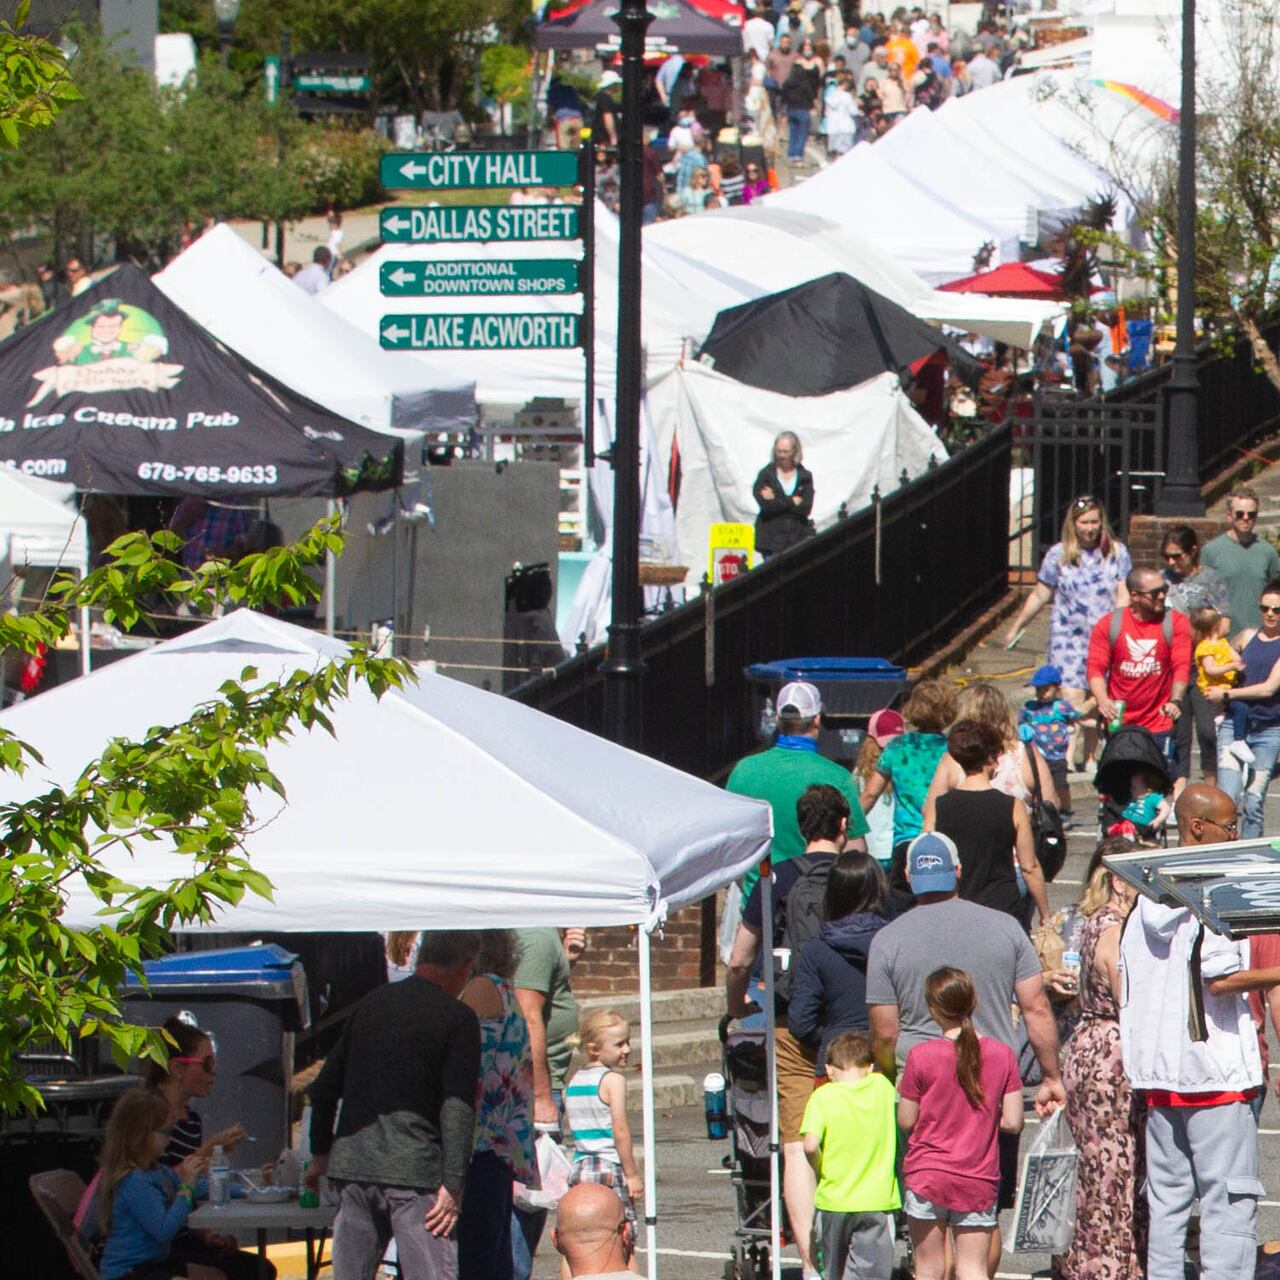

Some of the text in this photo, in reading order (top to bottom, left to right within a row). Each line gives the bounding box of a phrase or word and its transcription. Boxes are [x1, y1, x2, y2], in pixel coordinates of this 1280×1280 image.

[428, 154, 543, 185] CITY HALL
[411, 207, 576, 240] DALLAS STREET
[424, 262, 518, 277] ADDITIONAL
[423, 277, 566, 293] DOWNTOWN SHOPS
[410, 315, 575, 347] LAKE ACWORTH
[23, 412, 66, 429] Ice
[186, 411, 240, 429] Pub
[138, 462, 278, 484] 678-765-9633
[720, 562, 738, 575] STO
